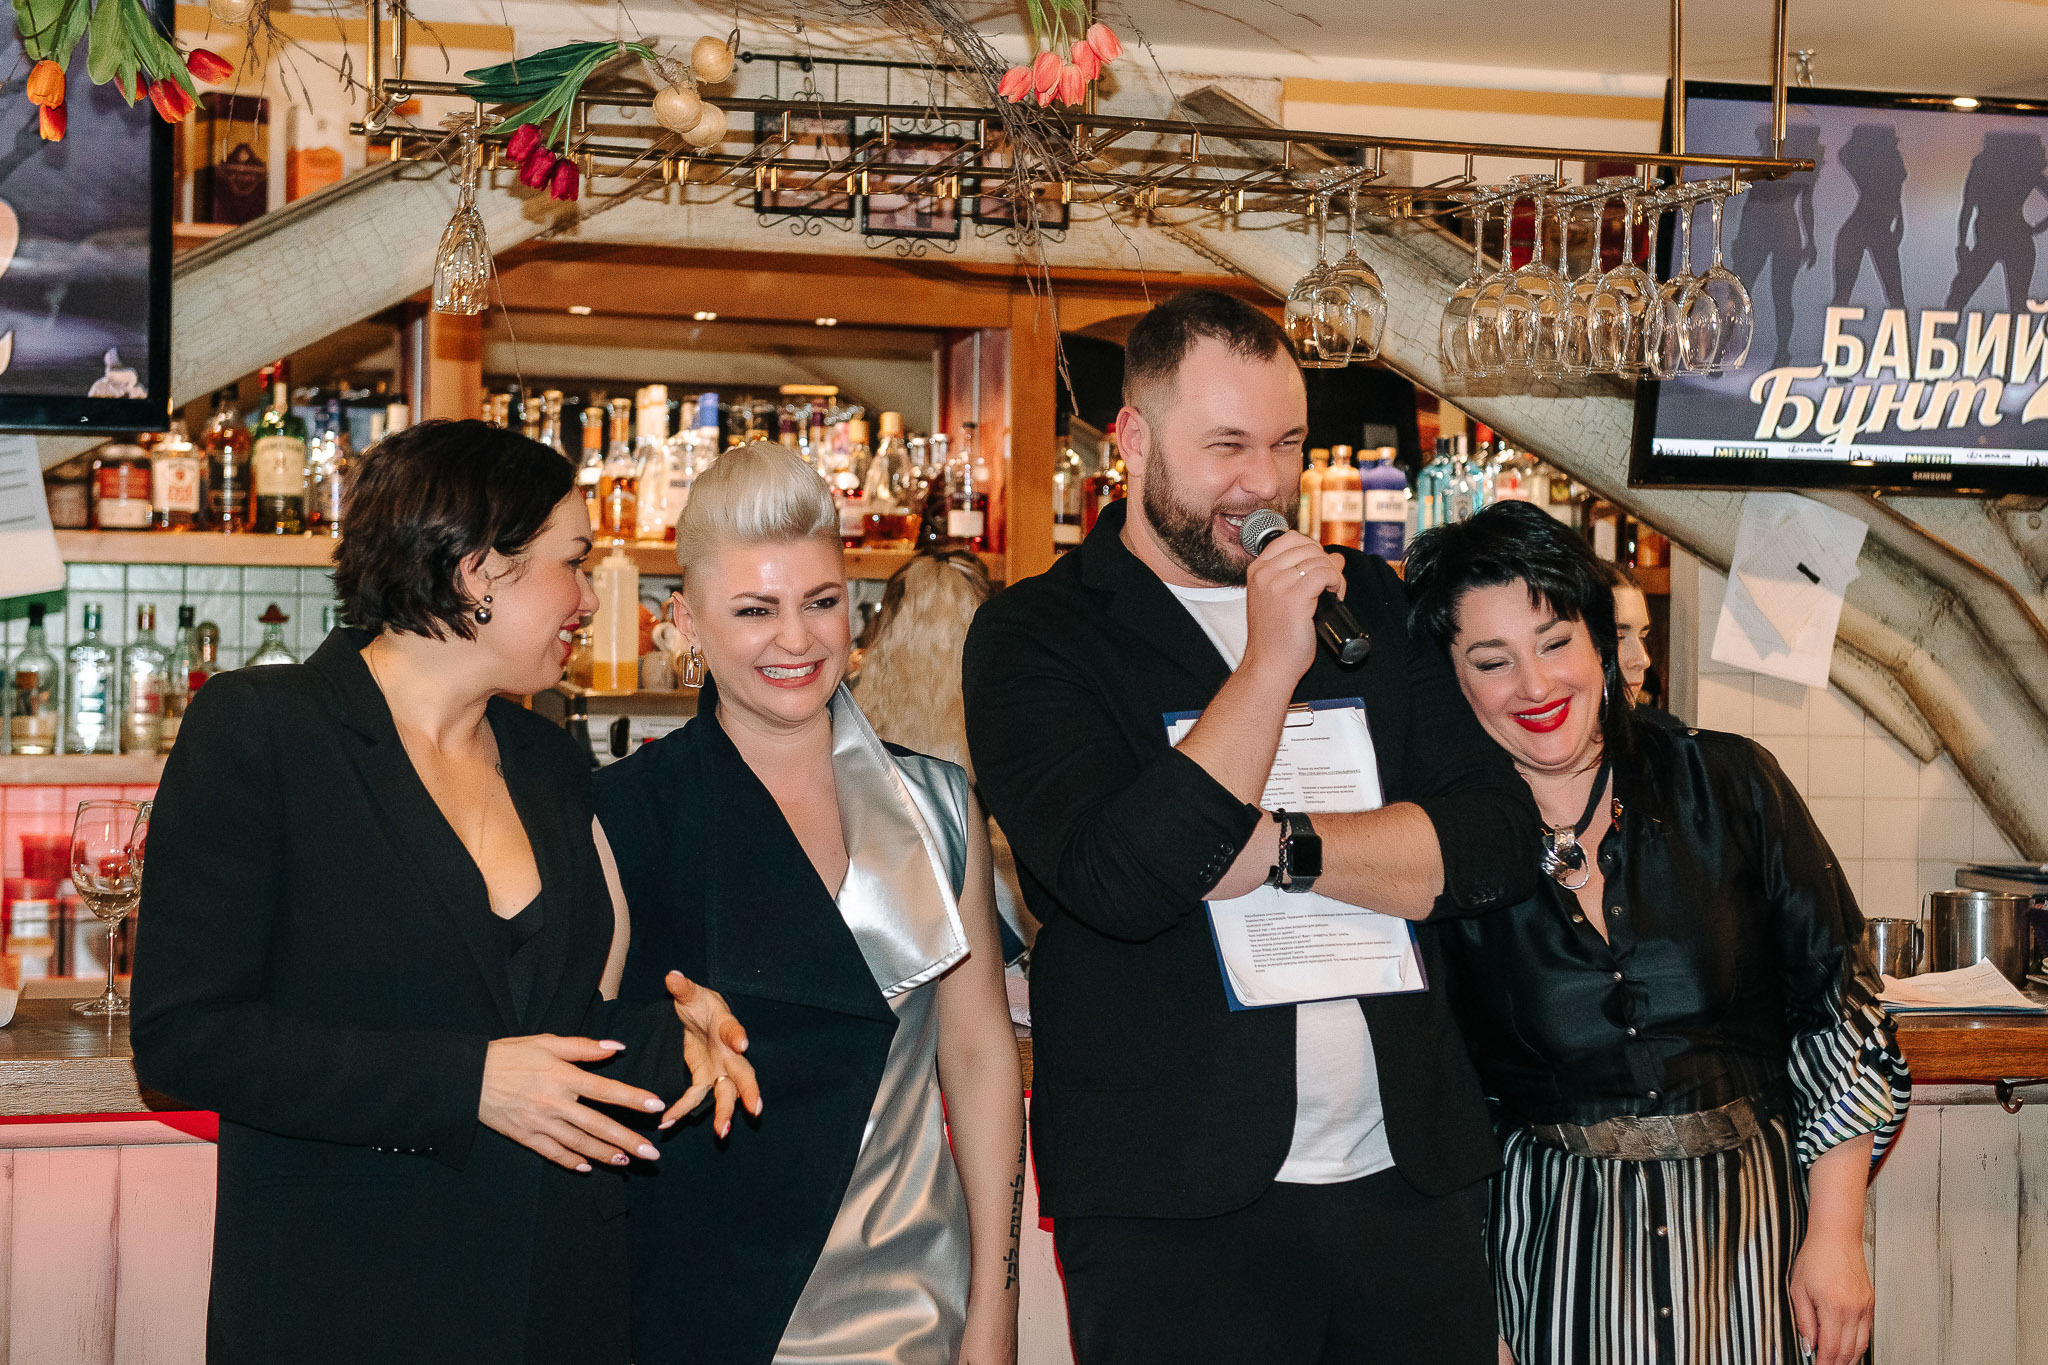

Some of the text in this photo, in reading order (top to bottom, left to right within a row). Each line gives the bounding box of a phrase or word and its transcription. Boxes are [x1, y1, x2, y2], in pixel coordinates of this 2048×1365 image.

[1822, 299, 2048, 384] БАБИЙ
[1750, 365, 2003, 445] Бунт
[1715, 447, 1768, 459] METRO
[1907, 454, 1952, 464] METRO
[1912, 471, 1952, 481] SAMSUNG
